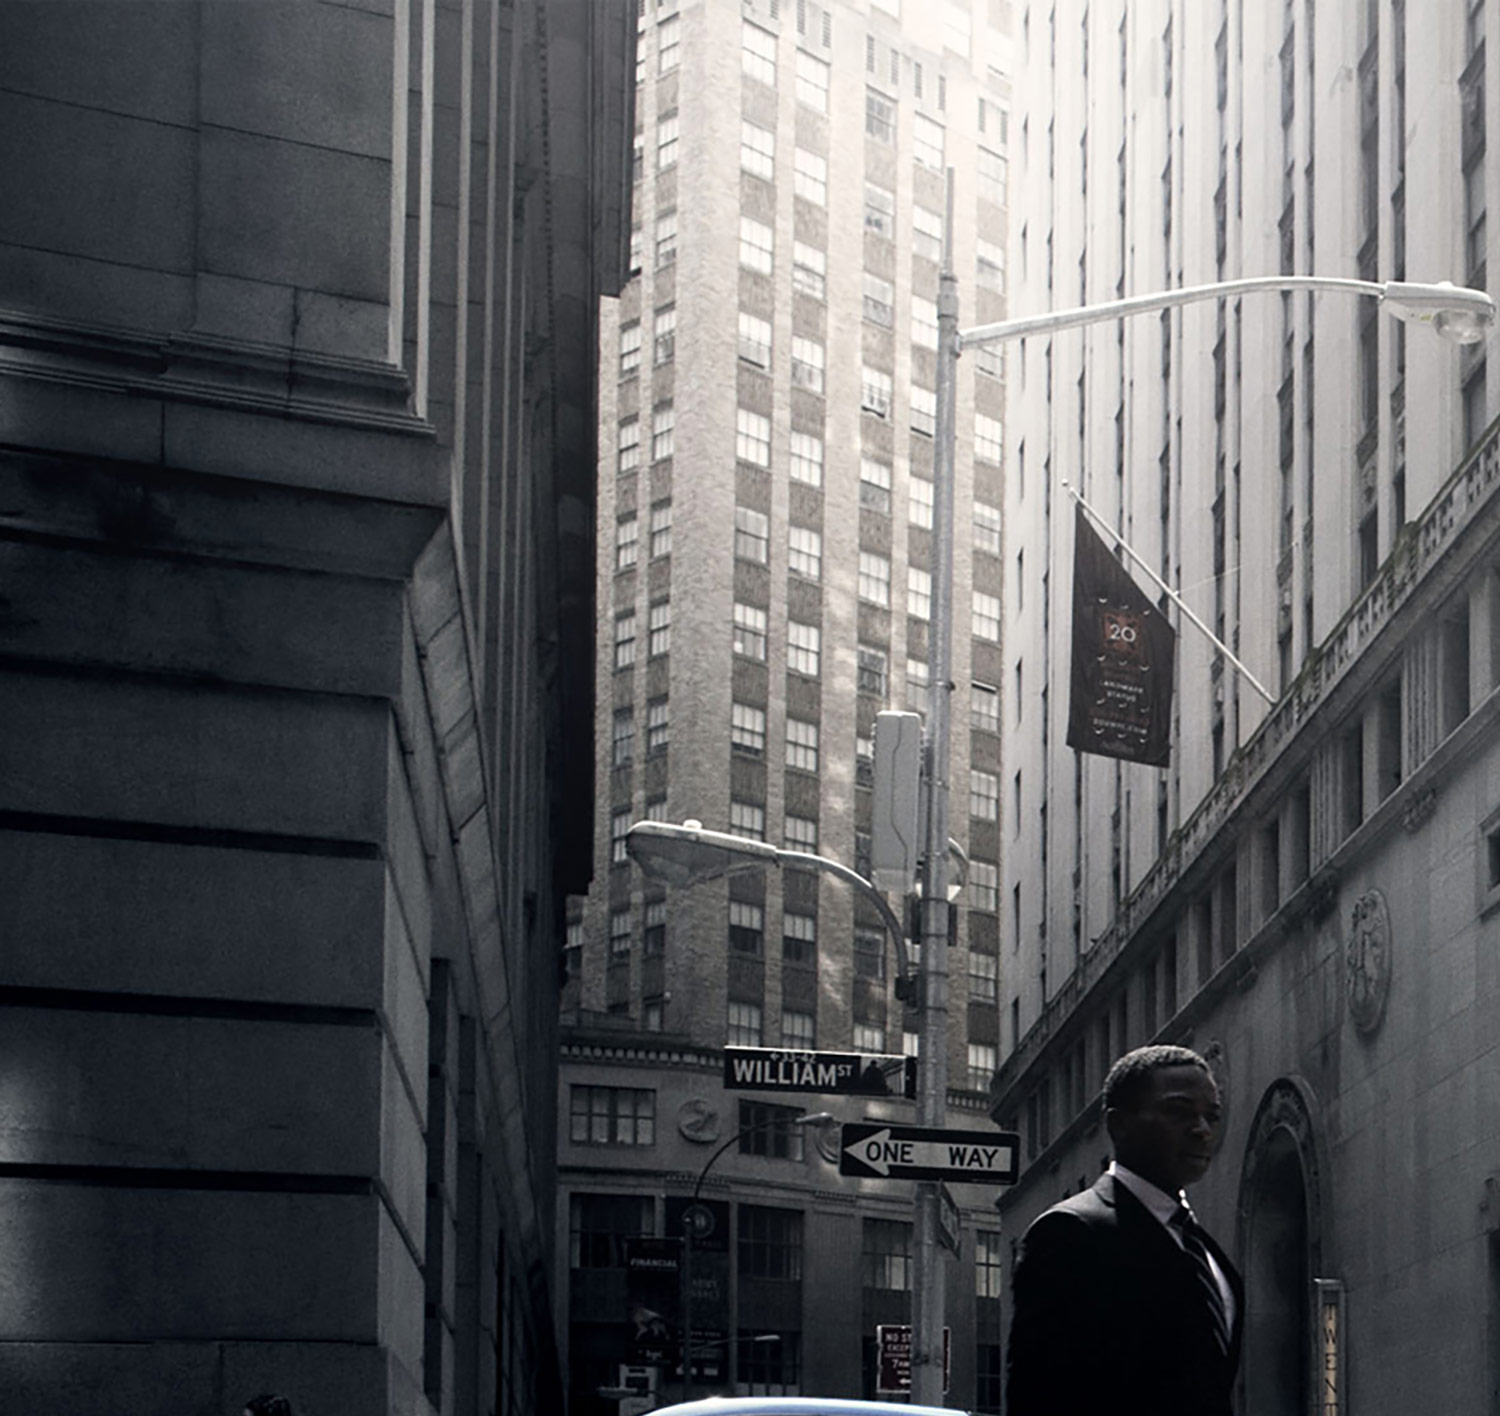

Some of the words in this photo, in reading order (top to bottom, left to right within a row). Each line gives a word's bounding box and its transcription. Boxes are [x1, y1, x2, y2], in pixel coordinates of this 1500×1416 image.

[1109, 623, 1137, 643] 20
[733, 1057, 838, 1087] WILLIAM
[837, 1063, 854, 1078] ST
[865, 1140, 914, 1164] ONE
[948, 1146, 999, 1168] WAY
